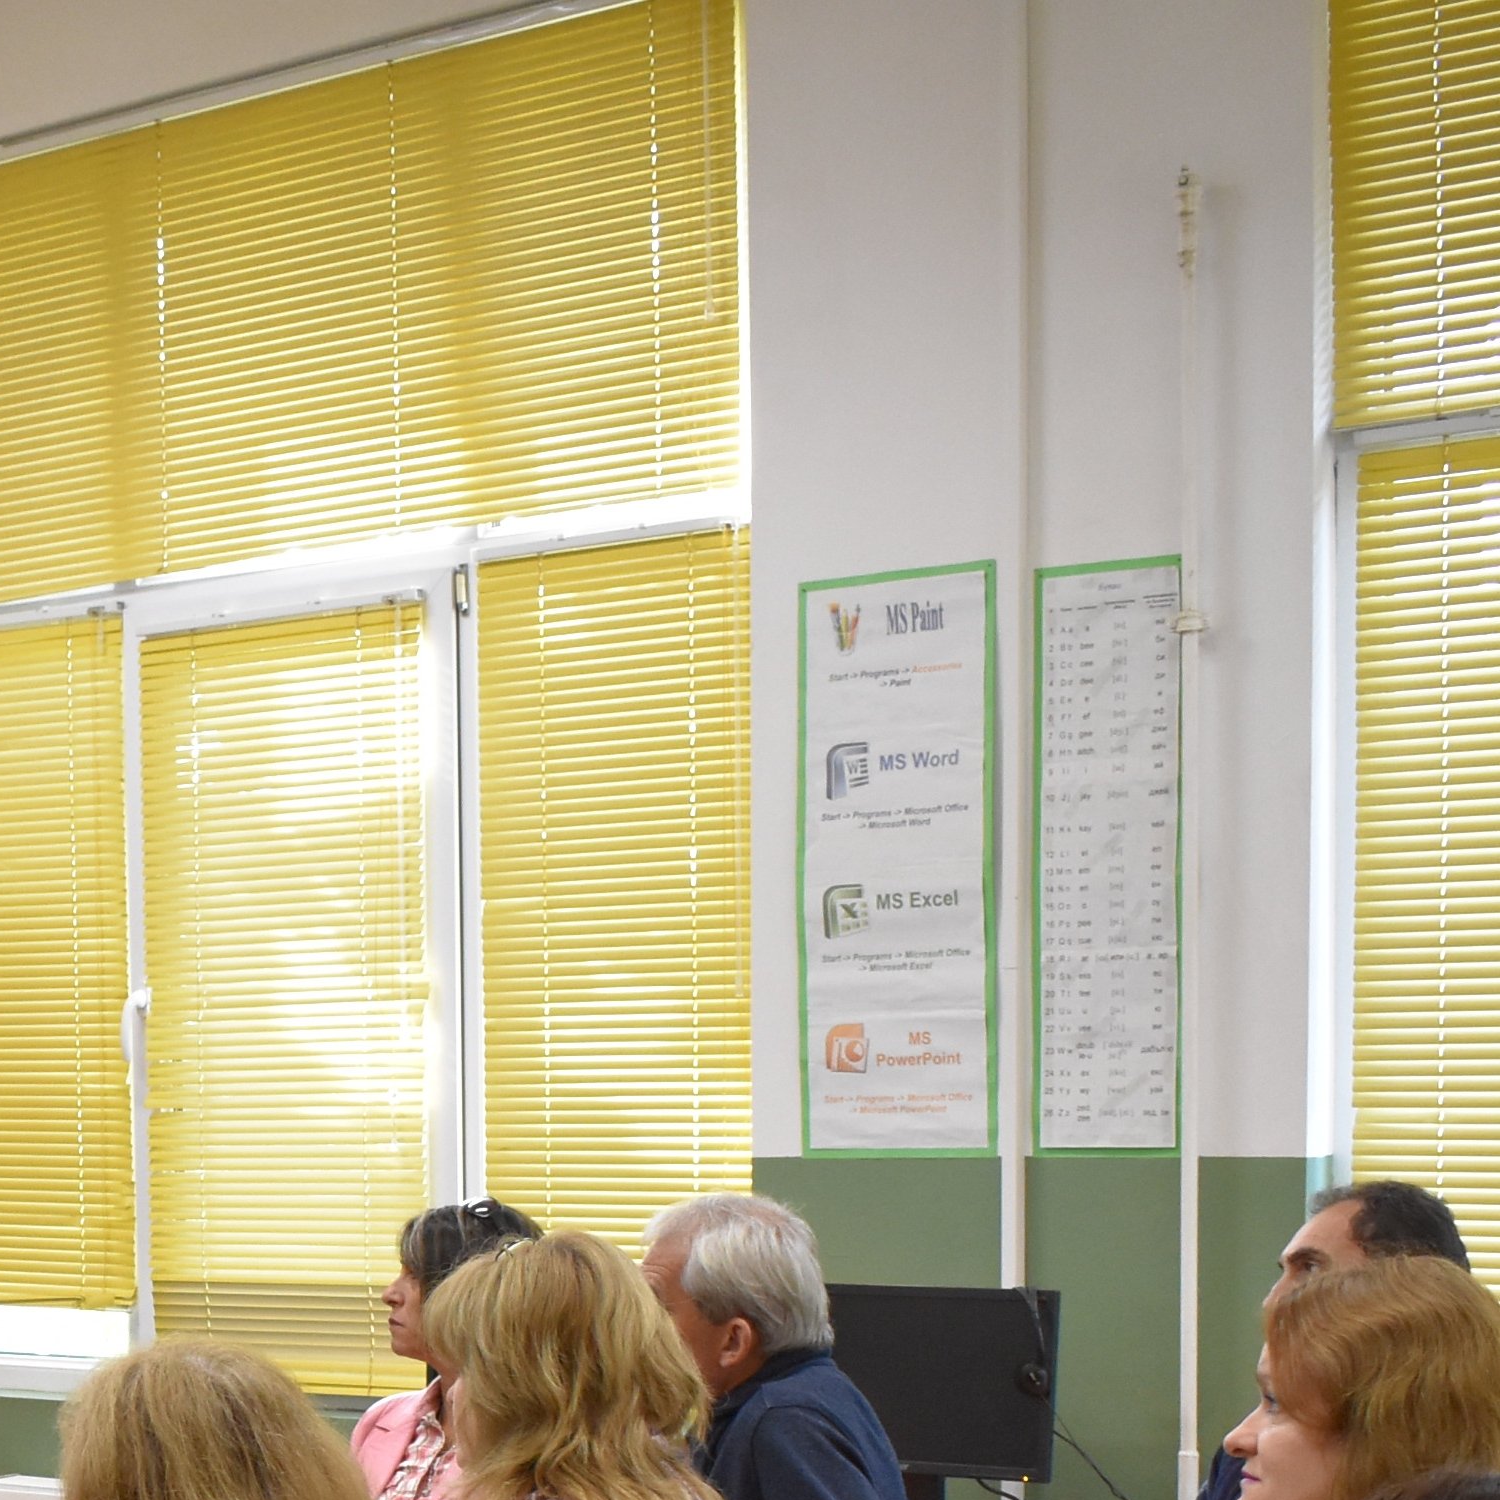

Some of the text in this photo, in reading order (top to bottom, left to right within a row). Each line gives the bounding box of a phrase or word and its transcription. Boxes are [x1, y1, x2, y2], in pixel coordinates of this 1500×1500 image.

[886, 601, 945, 635] MS Paint
[828, 662, 964, 682] Start Programs Accessories
[889, 678, 912, 688] Paint
[879, 749, 960, 771] MS Word
[821, 802, 969, 822] Start Programs Microsoft Office
[868, 817, 931, 830] Microsoft Word
[876, 889, 959, 910] MS Excel
[822, 948, 971, 963] Start Programs Microsoft Office
[869, 961, 933, 972] Microsoft Excel
[908, 1031, 933, 1046] MS
[876, 1052, 962, 1067] PowerPoint
